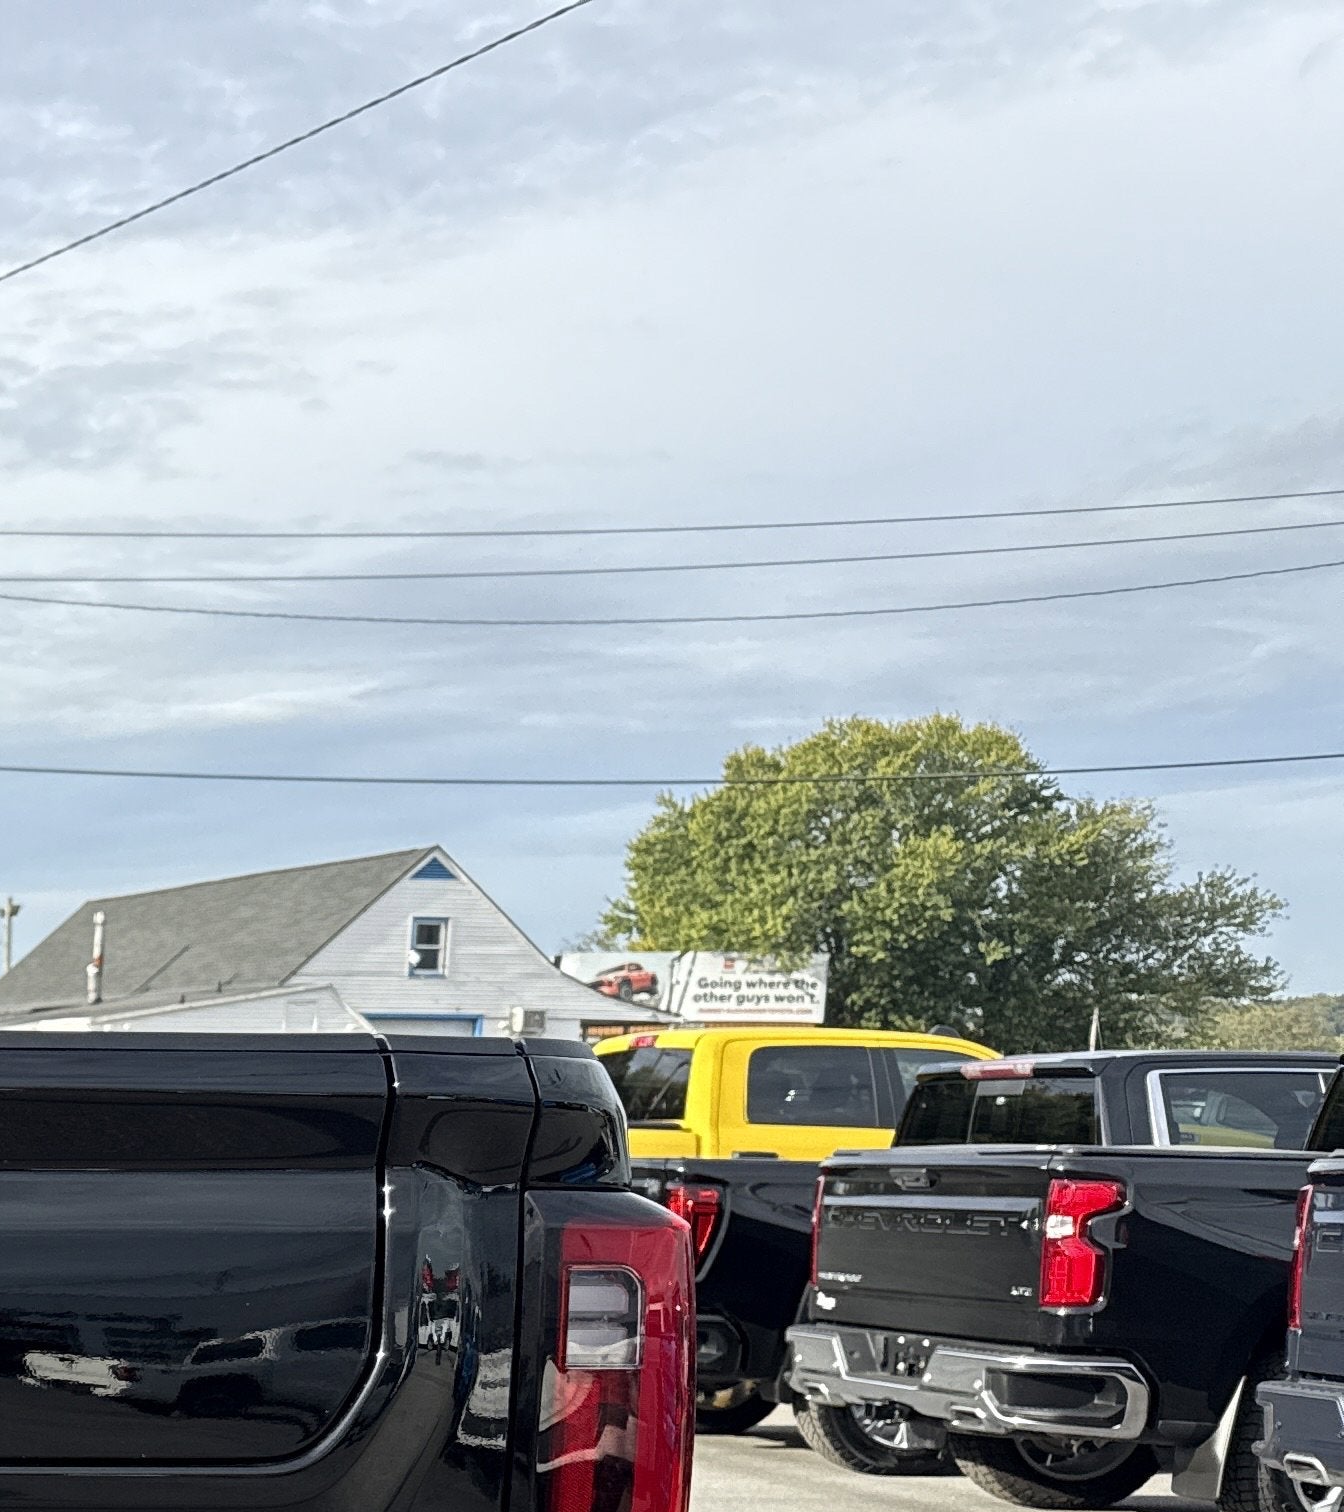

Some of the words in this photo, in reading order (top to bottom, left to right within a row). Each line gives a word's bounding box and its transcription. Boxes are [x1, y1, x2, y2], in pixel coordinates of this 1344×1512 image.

[697, 976, 742, 992] Going
[746, 978, 793, 989] where
[793, 978, 819, 990] the
[693, 992, 733, 1003] other
[736, 993, 770, 1006] guys
